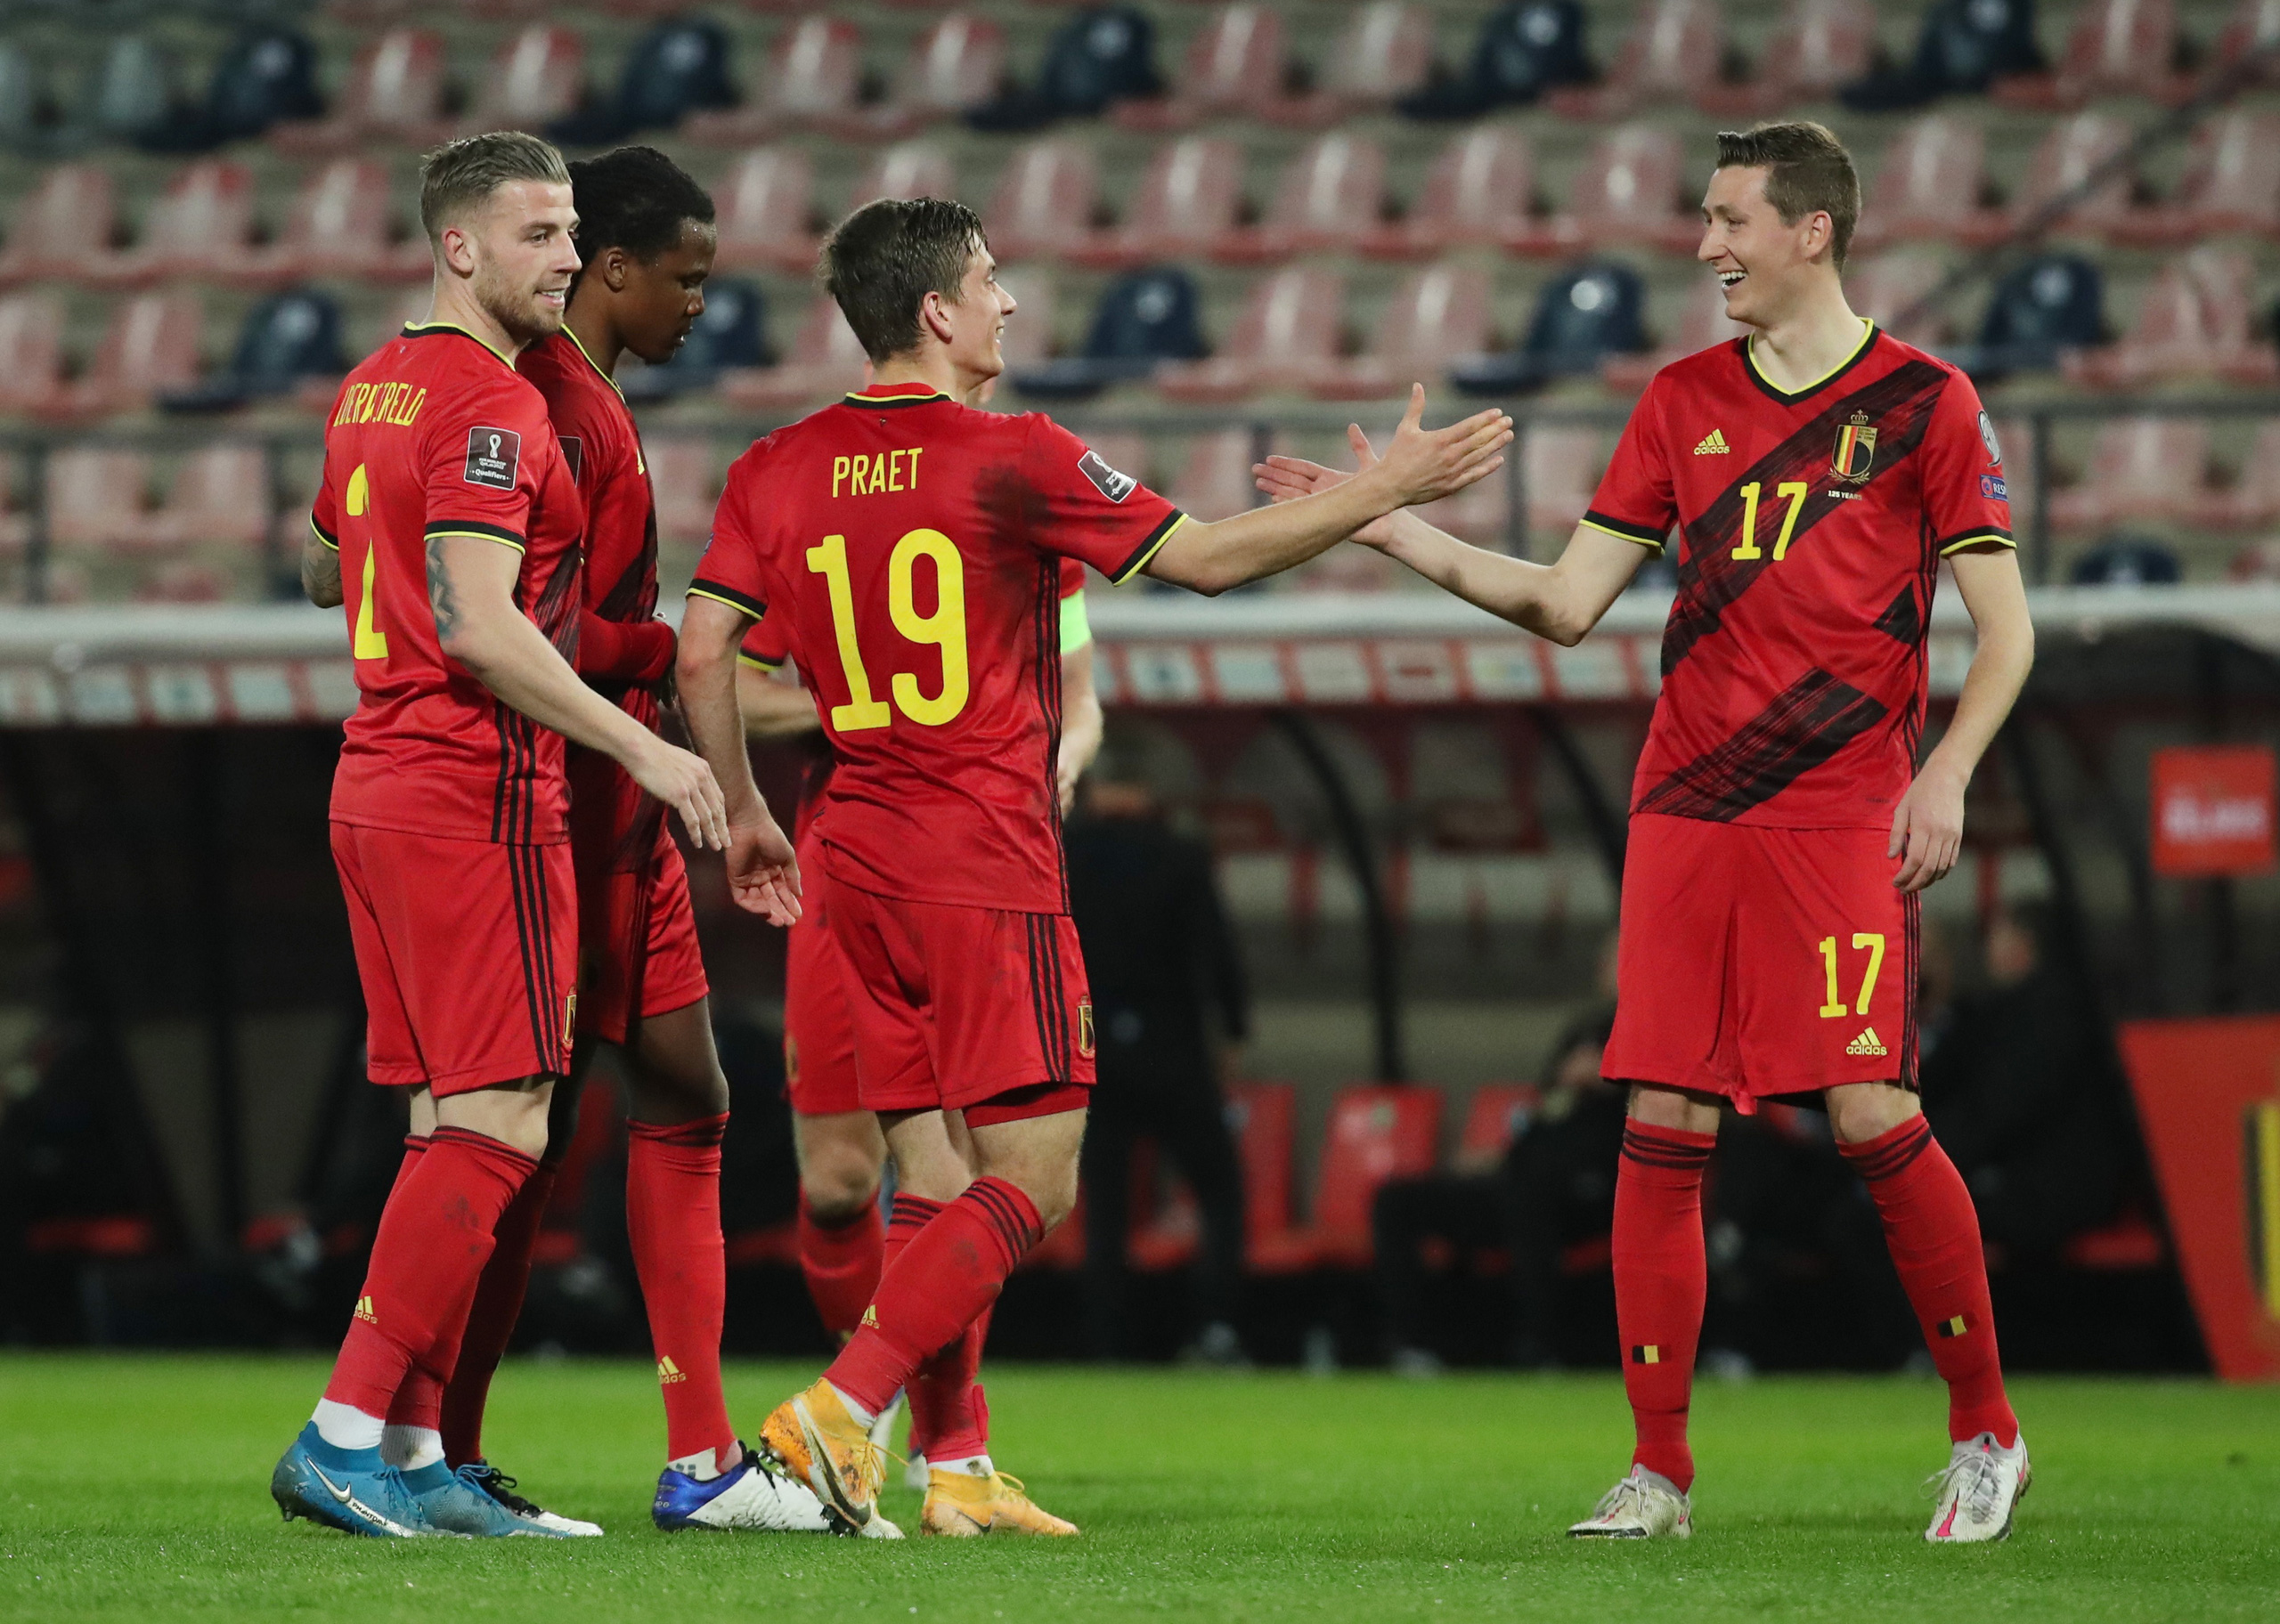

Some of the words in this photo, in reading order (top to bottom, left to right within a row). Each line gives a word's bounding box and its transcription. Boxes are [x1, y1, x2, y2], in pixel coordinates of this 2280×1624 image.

[1693, 443, 1730, 456] adidas
[475, 469, 507, 481] Qualifiers
[832, 447, 924, 499] PRAET
[1993, 483, 2007, 495] RES
[1828, 490, 1840, 499] 125
[1841, 491, 1862, 500] YEARS
[1730, 481, 1808, 562] 17
[346, 462, 389, 660] 2
[804, 527, 970, 733] 19
[1819, 933, 1885, 1019] 17
[1845, 1044, 1888, 1056] adidas
